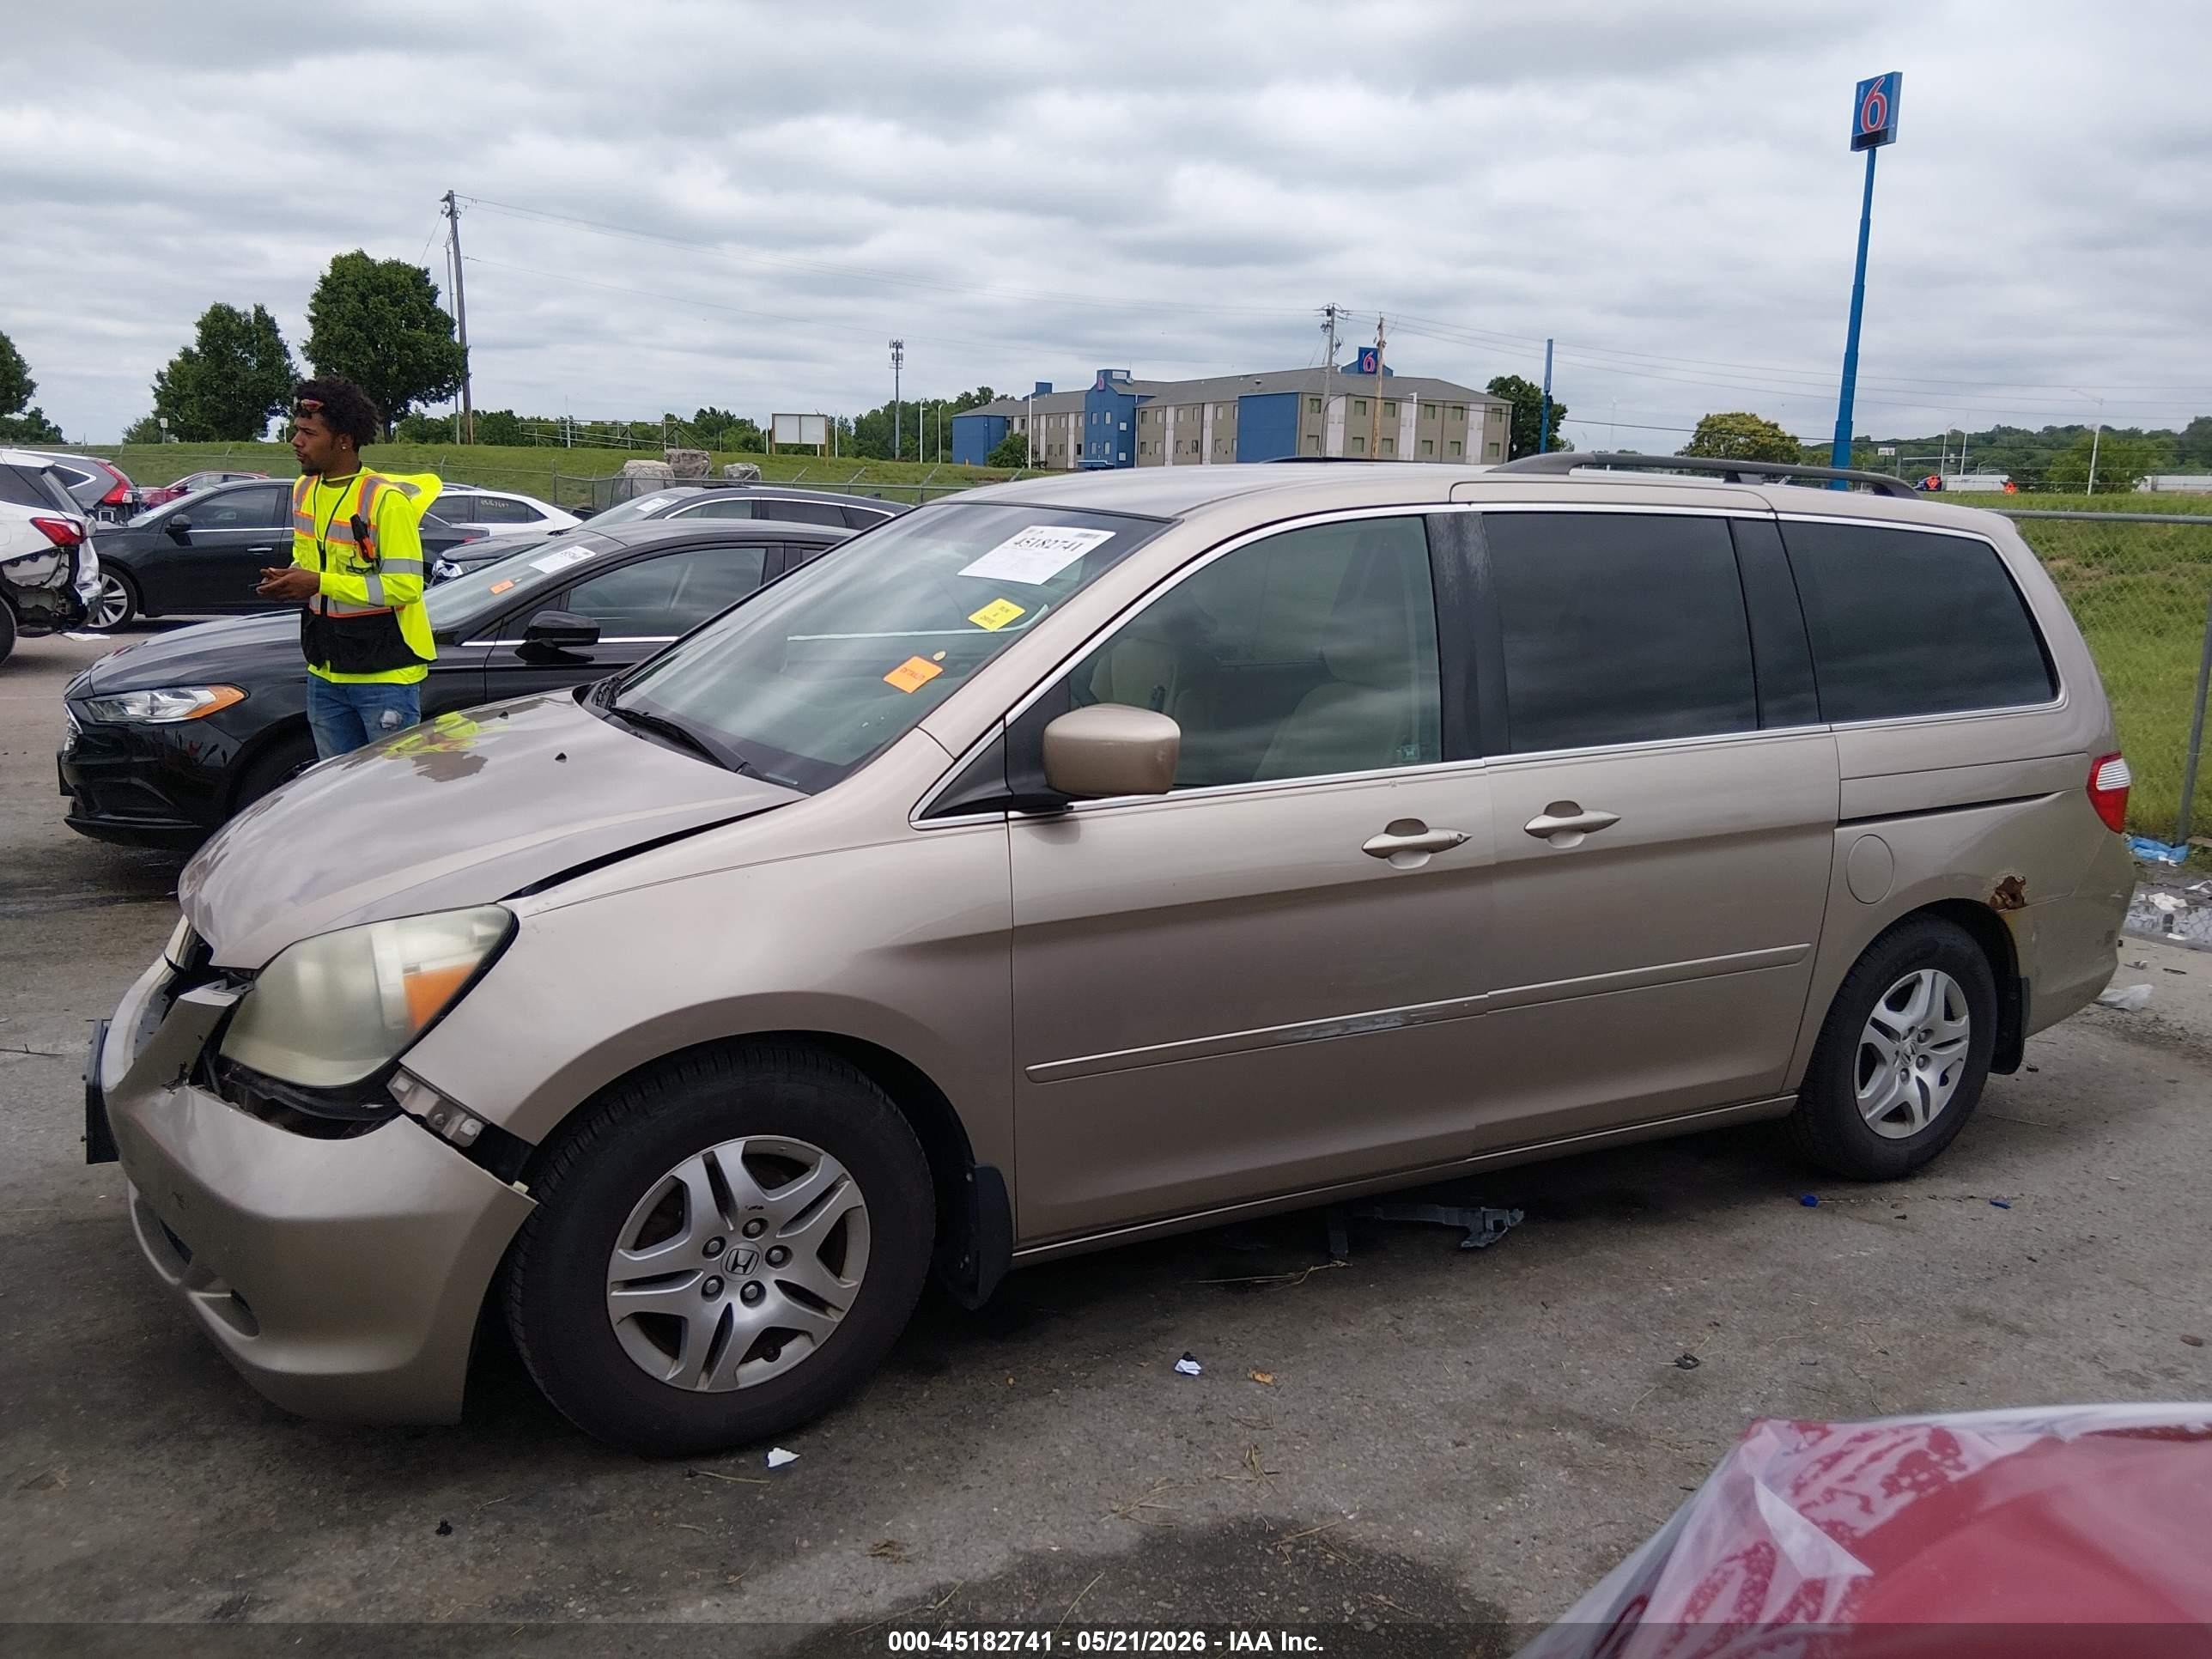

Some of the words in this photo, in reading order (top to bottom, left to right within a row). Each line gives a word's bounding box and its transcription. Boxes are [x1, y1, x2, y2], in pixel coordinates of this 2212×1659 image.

[1861, 76, 1887, 133] 6
[1363, 351, 1375, 372] 6
[1013, 537, 1084, 551] 45182741
